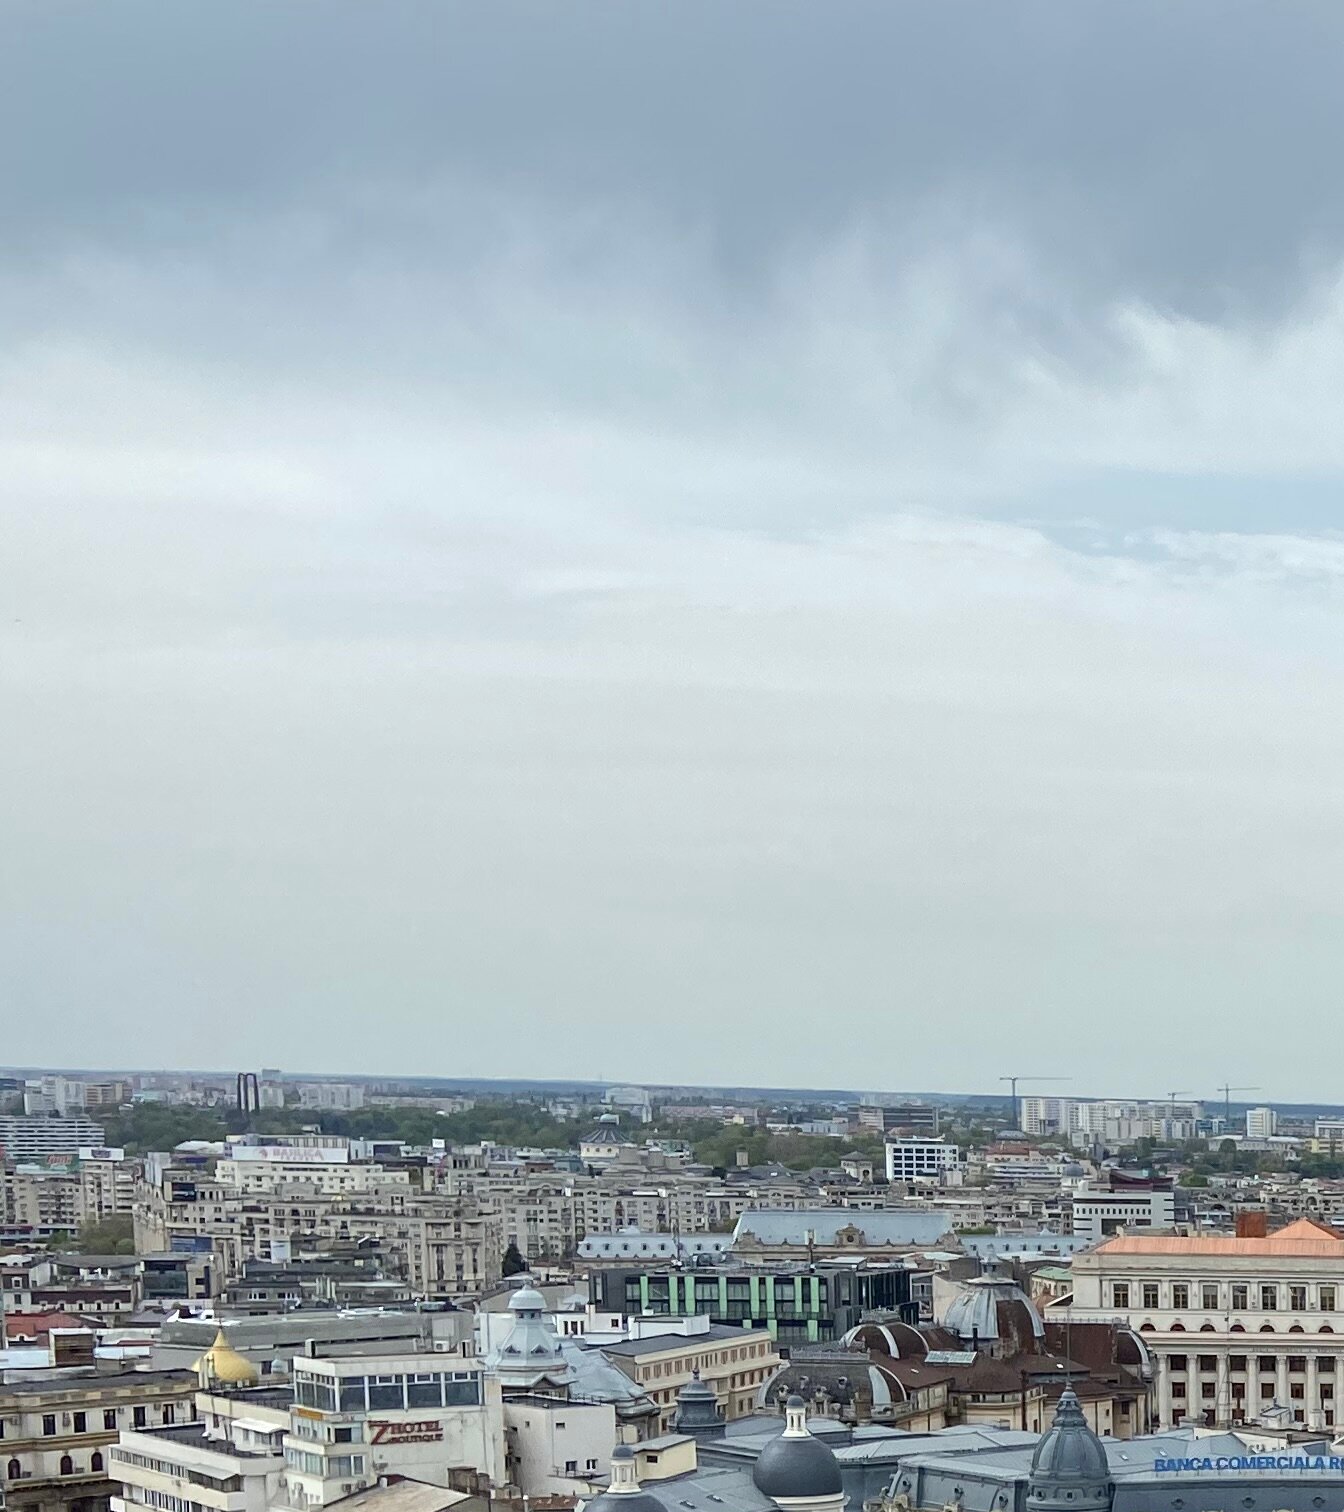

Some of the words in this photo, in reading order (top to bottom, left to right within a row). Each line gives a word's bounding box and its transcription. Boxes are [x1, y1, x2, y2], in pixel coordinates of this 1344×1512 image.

[391, 1421, 443, 1434] HOTEL
[1154, 1458, 1213, 1472] BANCA
[1216, 1456, 1325, 1470] COMERCIALA
